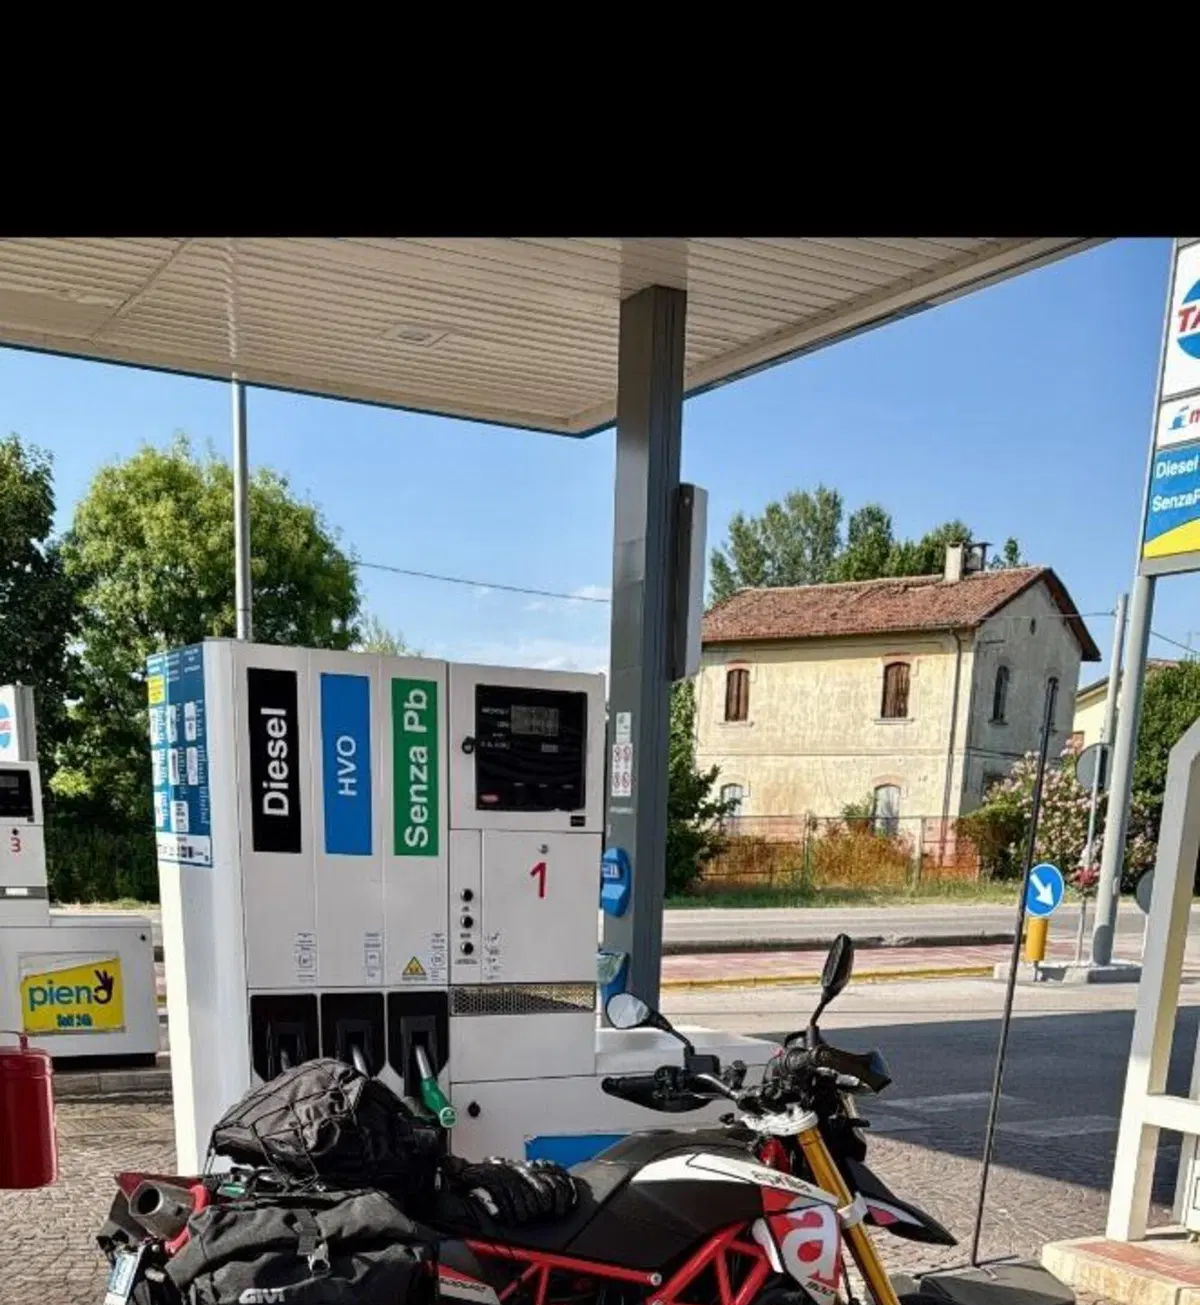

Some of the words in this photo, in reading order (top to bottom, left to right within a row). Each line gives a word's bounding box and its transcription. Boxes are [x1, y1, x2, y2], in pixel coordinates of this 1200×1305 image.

[1155, 454, 1200, 479] Diesel
[403, 688, 428, 733] Pb
[260, 706, 290, 816] Diesel
[336, 735, 358, 796] HVO
[404, 745, 429, 848] Senza
[11, 837, 22, 853] 3
[530, 862, 547, 898] 1
[28, 970, 114, 1012] pieno
[239, 1288, 285, 1304] GIVI
